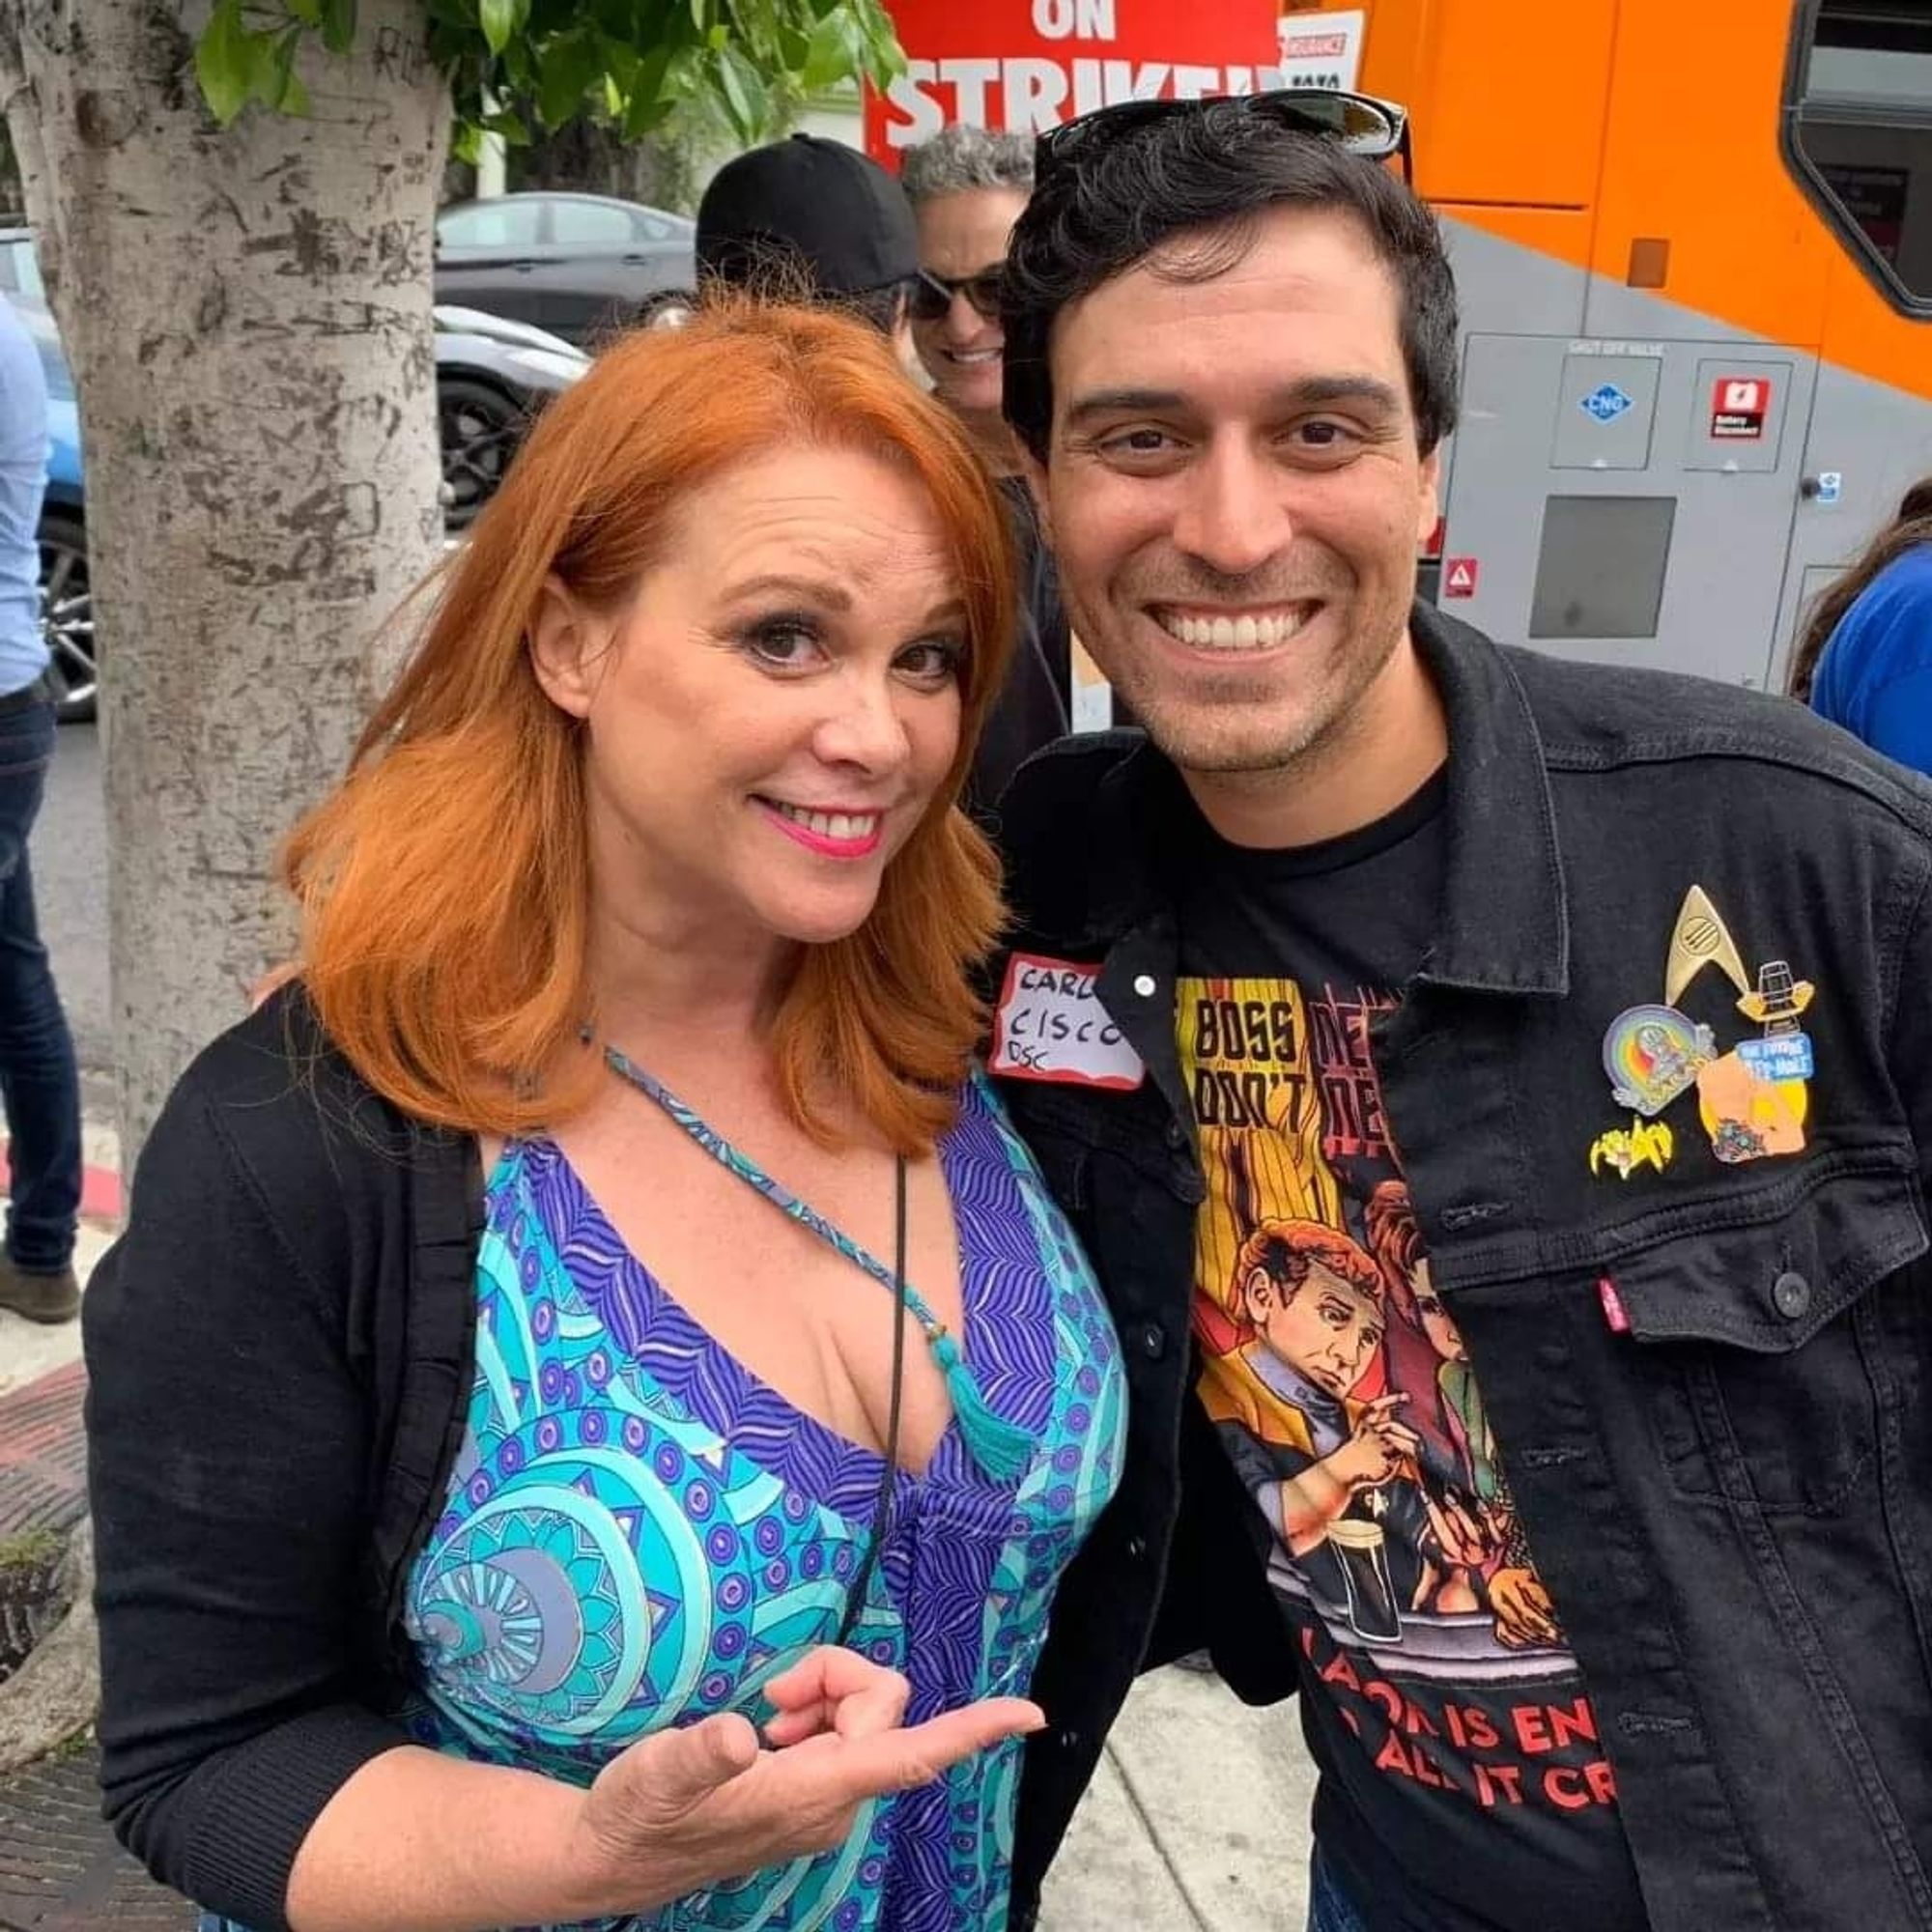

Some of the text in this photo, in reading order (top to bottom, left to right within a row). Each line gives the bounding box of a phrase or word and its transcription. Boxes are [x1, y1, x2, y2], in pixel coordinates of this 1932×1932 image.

[1032, 0, 1116, 40] ON
[1010, 1009, 1121, 1046] CISCO
[1195, 999, 1296, 1063] BOSS
[1008, 1040, 1049, 1071] DSC
[1195, 1067, 1306, 1134] DON'T
[1444, 1704, 1498, 1748] IS
[1512, 1697, 1598, 1754] EN
[1473, 1762, 1523, 1806] IT
